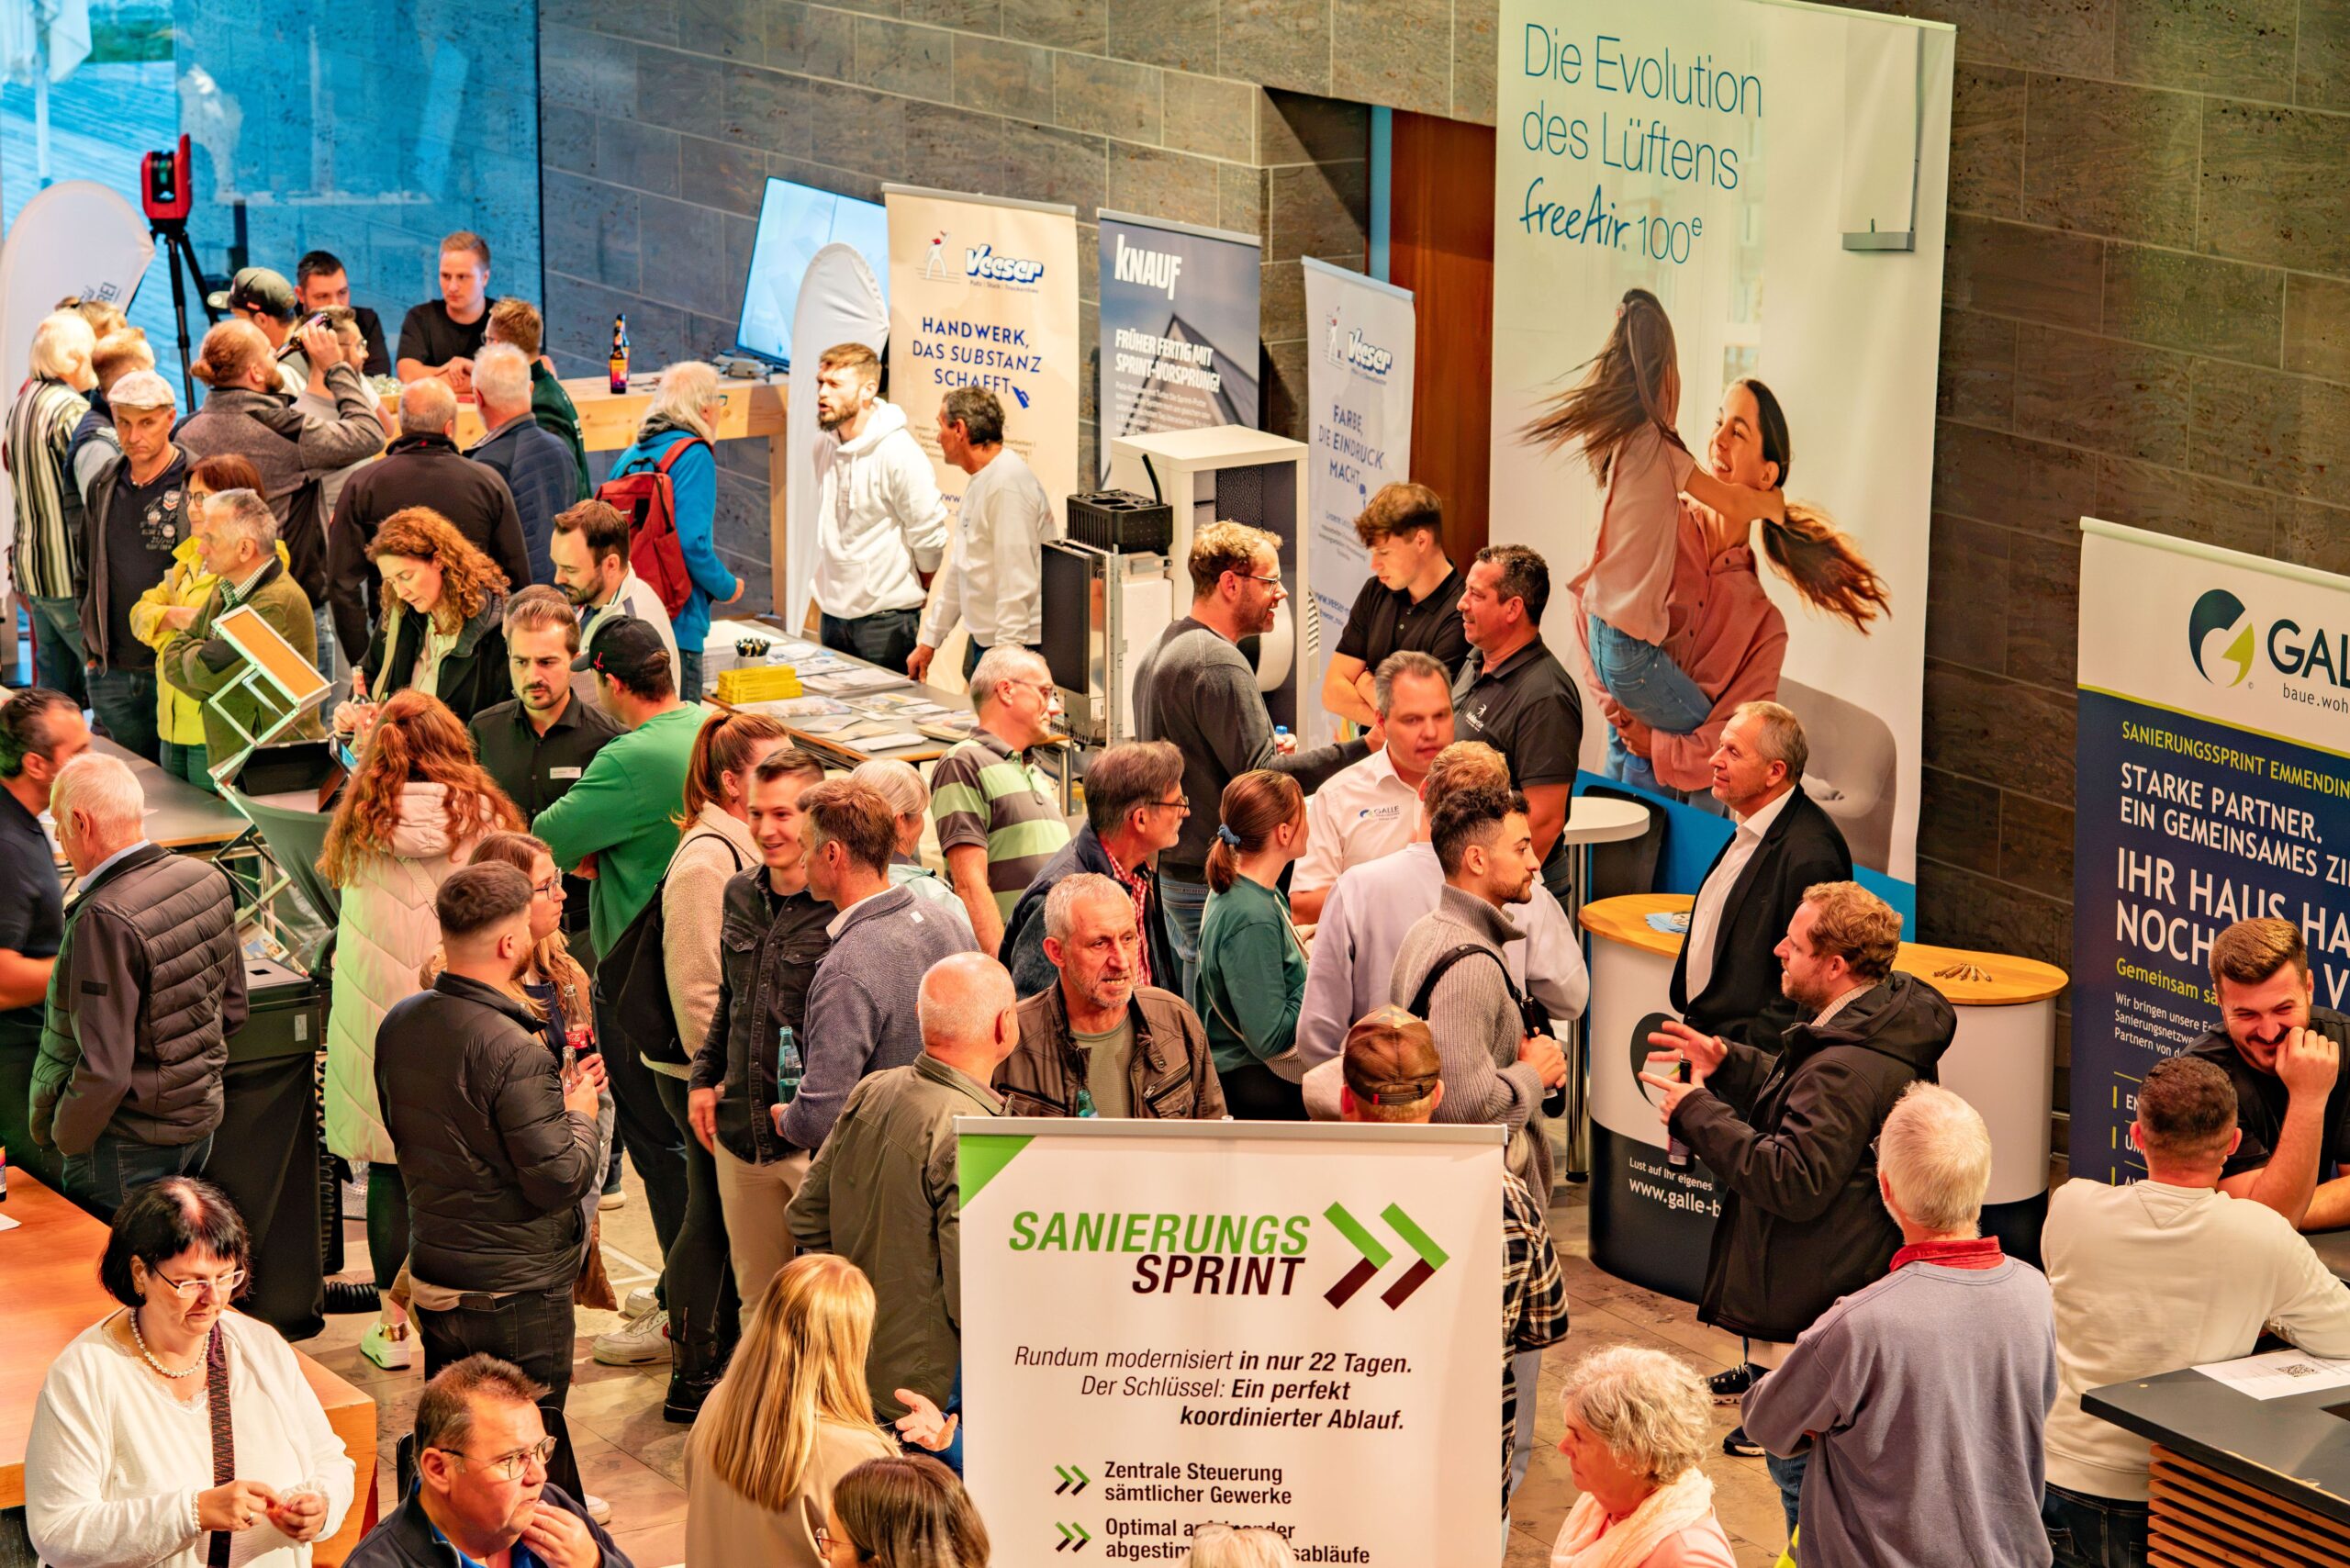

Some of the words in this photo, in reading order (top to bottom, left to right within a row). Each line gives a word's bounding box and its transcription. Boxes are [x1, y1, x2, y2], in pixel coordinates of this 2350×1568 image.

[1525, 23, 1582, 84] Die
[1595, 35, 1762, 118] Evolution
[1523, 100, 1589, 160] des
[1604, 111, 1739, 190] Lüftens
[923, 317, 1029, 349] HANDWERK,
[1115, 328, 1157, 359] FRÜHER
[1157, 337, 1192, 362] FERTIG
[1192, 344, 1214, 367] MIT
[913, 341, 945, 359] DAS
[951, 346, 1042, 373] SUBSTANZ
[1115, 353, 1221, 393] SPRINT-VORSPRUNG!
[934, 368, 1011, 394] SCHAFFT
[1333, 404, 1364, 437] FARBE,
[1318, 424, 1331, 447] DIE
[1333, 431, 1384, 471] EINDRUCK
[1329, 460, 1360, 488] MACHT
[2283, 683, 2349, 714] baue.woh
[2121, 721, 2266, 776] SANIERUNGSSPRINT
[2270, 760, 2350, 800] EMMENDIN
[2121, 762, 2203, 810] STARKE
[2211, 787, 2322, 845] PARTNER.
[2121, 795, 2155, 830] EIN
[2163, 809, 2318, 877] GEMEINSAMES
[2118, 846, 2177, 905] IHR
[2189, 868, 2286, 922] HAUS
[2117, 899, 2215, 966] NOCH
[2116, 958, 2199, 1000] Gemeinsam
[2114, 1009, 2195, 1045] Sanierungsnetzwe
[2115, 991, 2131, 1008] Wir
[2133, 997, 2166, 1019] bringen
[2169, 1012, 2199, 1030] unsere
[2114, 1026, 2154, 1051] Partnern
[2155, 1042, 2172, 1057] von
[1629, 1157, 1647, 1172] Lust
[1648, 1164, 1662, 1176] auf
[1663, 1168, 1676, 1181] Ihr
[1677, 1174, 1713, 1192] eigenes
[1628, 1178, 1721, 1218] www.galle-b
[1009, 1210, 1311, 1256] SANIERUNGS
[1131, 1254, 1306, 1296] SPRINT
[1014, 1346, 1098, 1367] Rundum
[1105, 1349, 1234, 1370] modernisiert
[1239, 1350, 1259, 1370] in
[1266, 1353, 1304, 1371] nur
[1308, 1351, 1337, 1372] 22
[1344, 1352, 1412, 1377] Tagen.
[1081, 1375, 1117, 1395] Der
[1123, 1376, 1225, 1397] Schlüssel:
[1231, 1379, 1264, 1398] Ein
[1270, 1380, 1350, 1403] perfekt
[1180, 1406, 1322, 1428] koordinierter
[1327, 1408, 1404, 1429] Ablauf.
[1104, 1461, 1181, 1480] Zentrale
[1187, 1462, 1282, 1485] Steuerung
[1104, 1484, 1204, 1502] sämtlicher
[1210, 1485, 1292, 1505] Gewerke
[1105, 1518, 1177, 1539] Optimal
